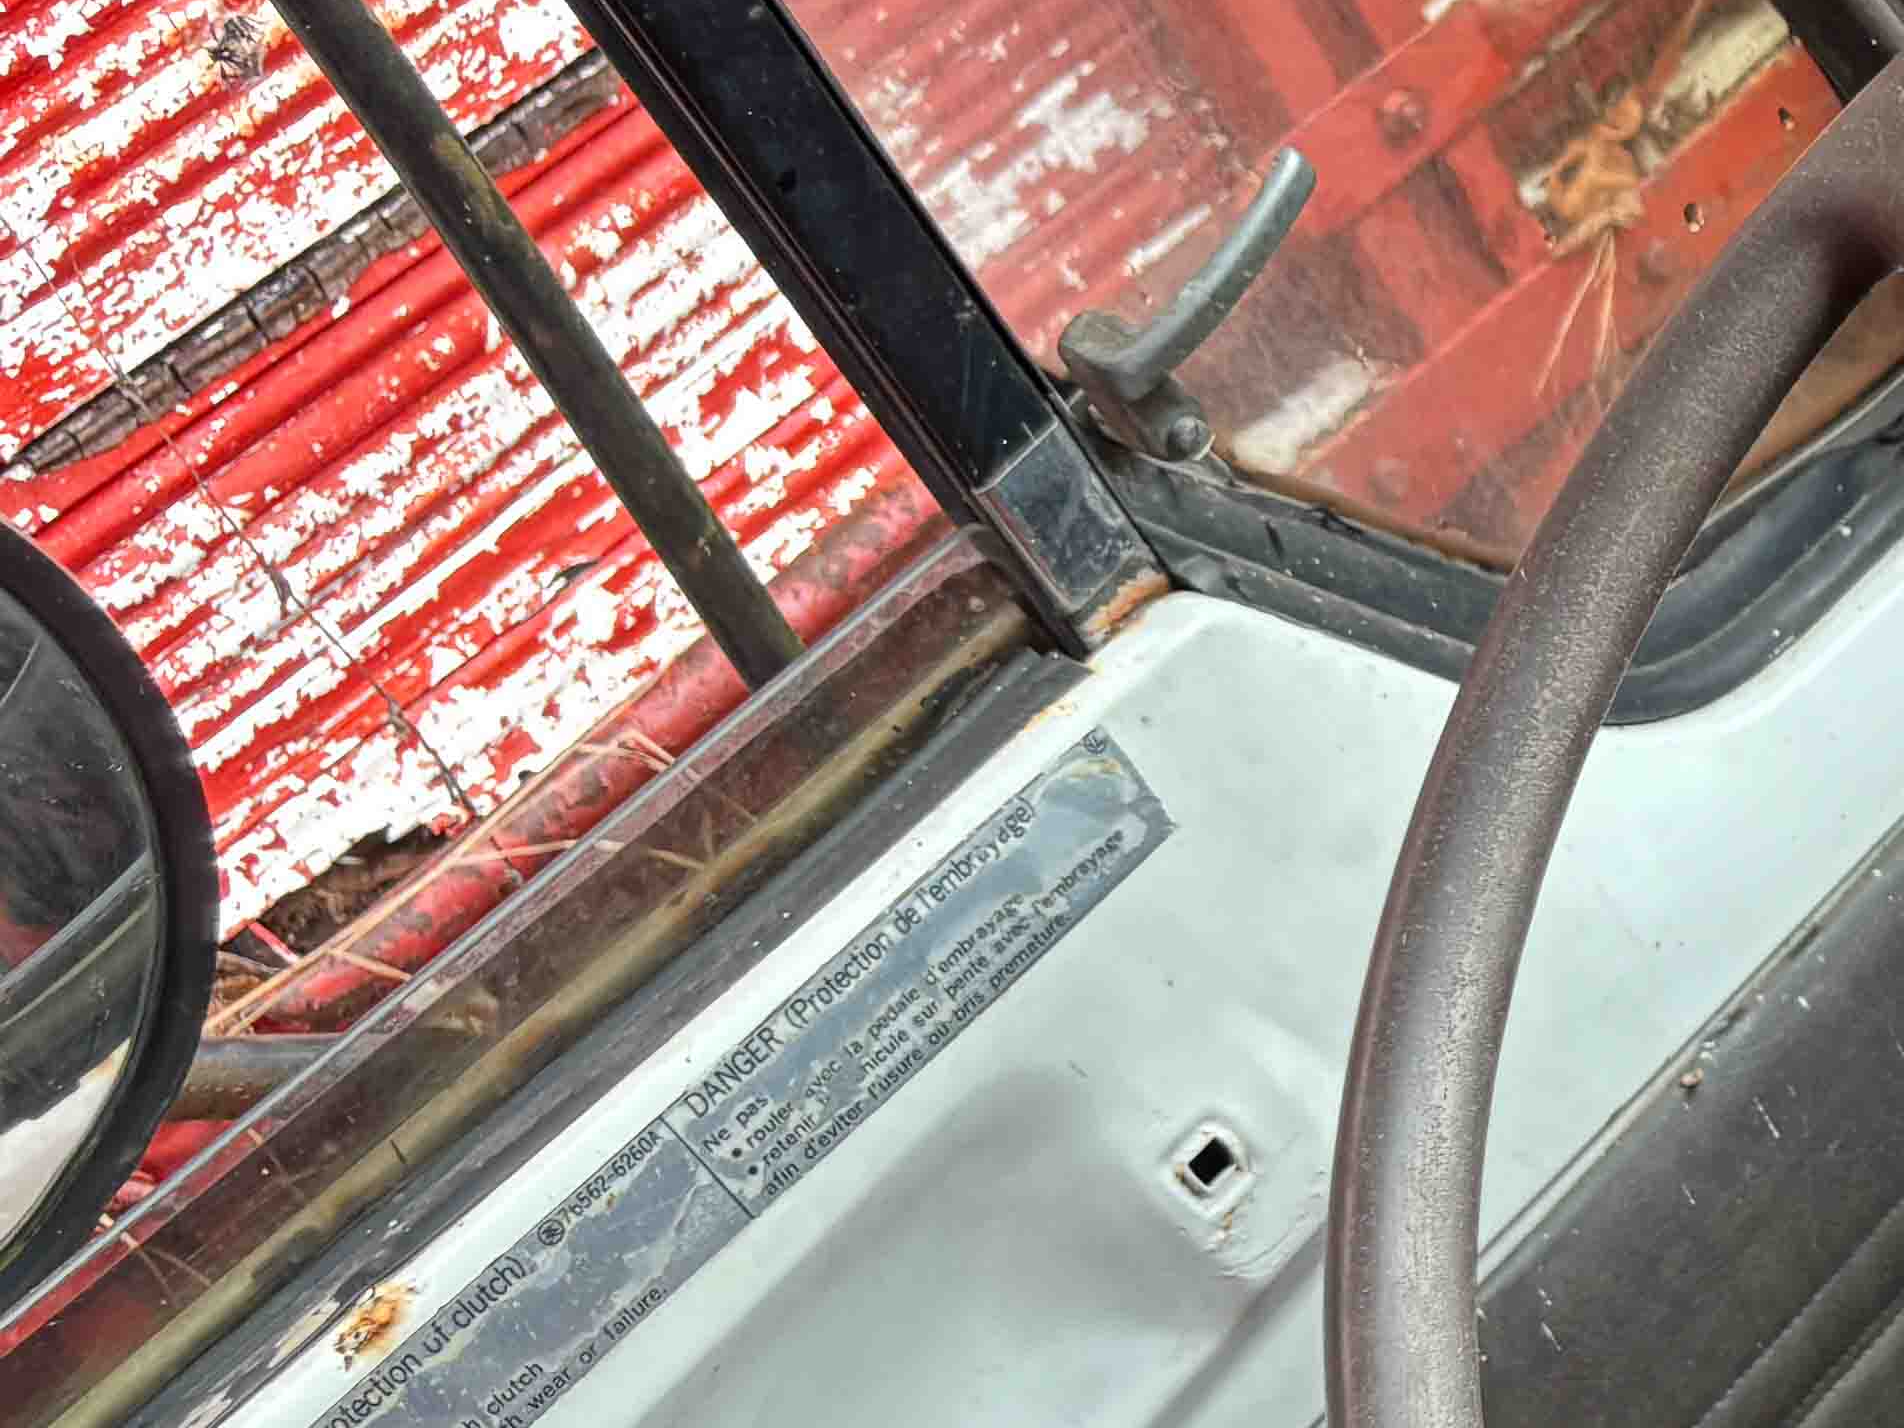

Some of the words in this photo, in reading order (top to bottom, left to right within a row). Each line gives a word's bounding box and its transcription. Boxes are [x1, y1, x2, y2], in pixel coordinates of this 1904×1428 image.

[685, 1027, 785, 1119] DANGER
[784, 929, 895, 1029] (Protection
[893, 902, 923, 935] de
[762, 1113, 817, 1168] retenir
[912, 1000, 940, 1028] sur
[944, 955, 991, 1002] pente
[991, 914, 1034, 955] avec
[702, 1127, 730, 1155] Ne
[735, 1095, 769, 1129] pas
[746, 1102, 795, 1149] rouler
[764, 1162, 801, 1197] afin
[867, 1047, 925, 1101] l'usure
[927, 1020, 952, 1047] ou
[953, 990, 986, 1025] bris
[451, 1254, 529, 1330] clutch)
[486, 1361, 544, 1416] clutch
[527, 1367, 574, 1413] wear
[579, 1341, 600, 1366] or
[602, 1286, 668, 1343] failure.
